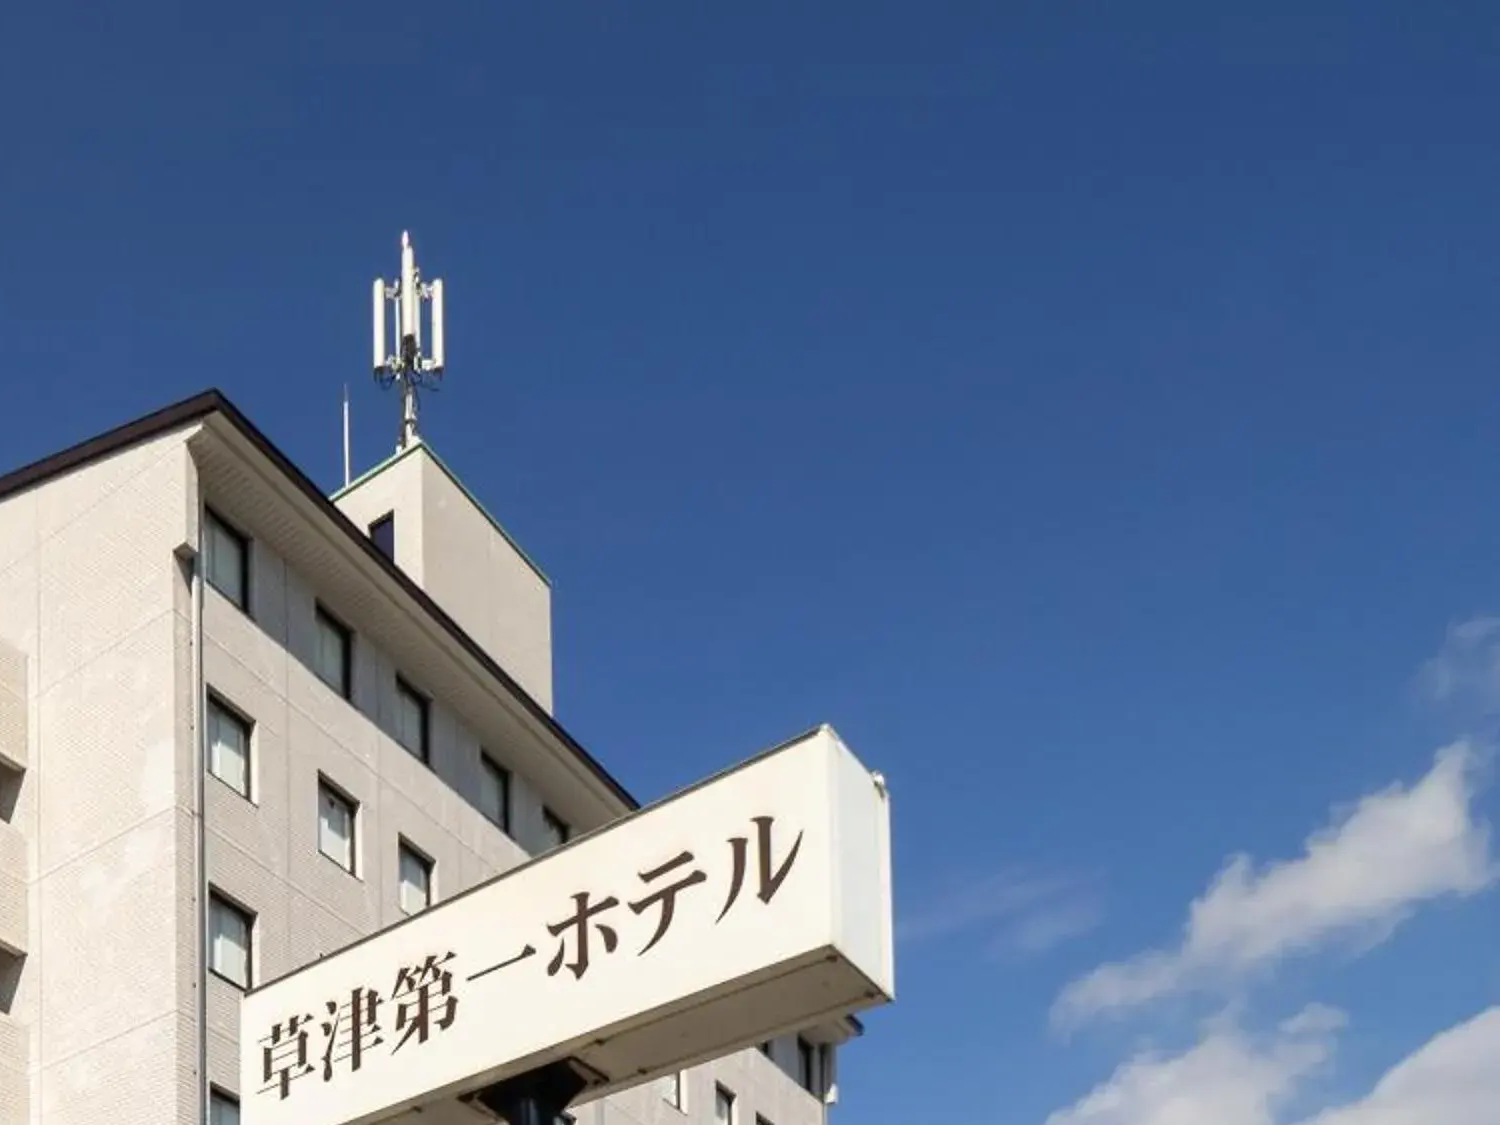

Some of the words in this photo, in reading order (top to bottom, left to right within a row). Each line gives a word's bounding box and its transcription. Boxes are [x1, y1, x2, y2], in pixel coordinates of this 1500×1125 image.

[256, 815, 804, 1100] 草津第一ホテル
